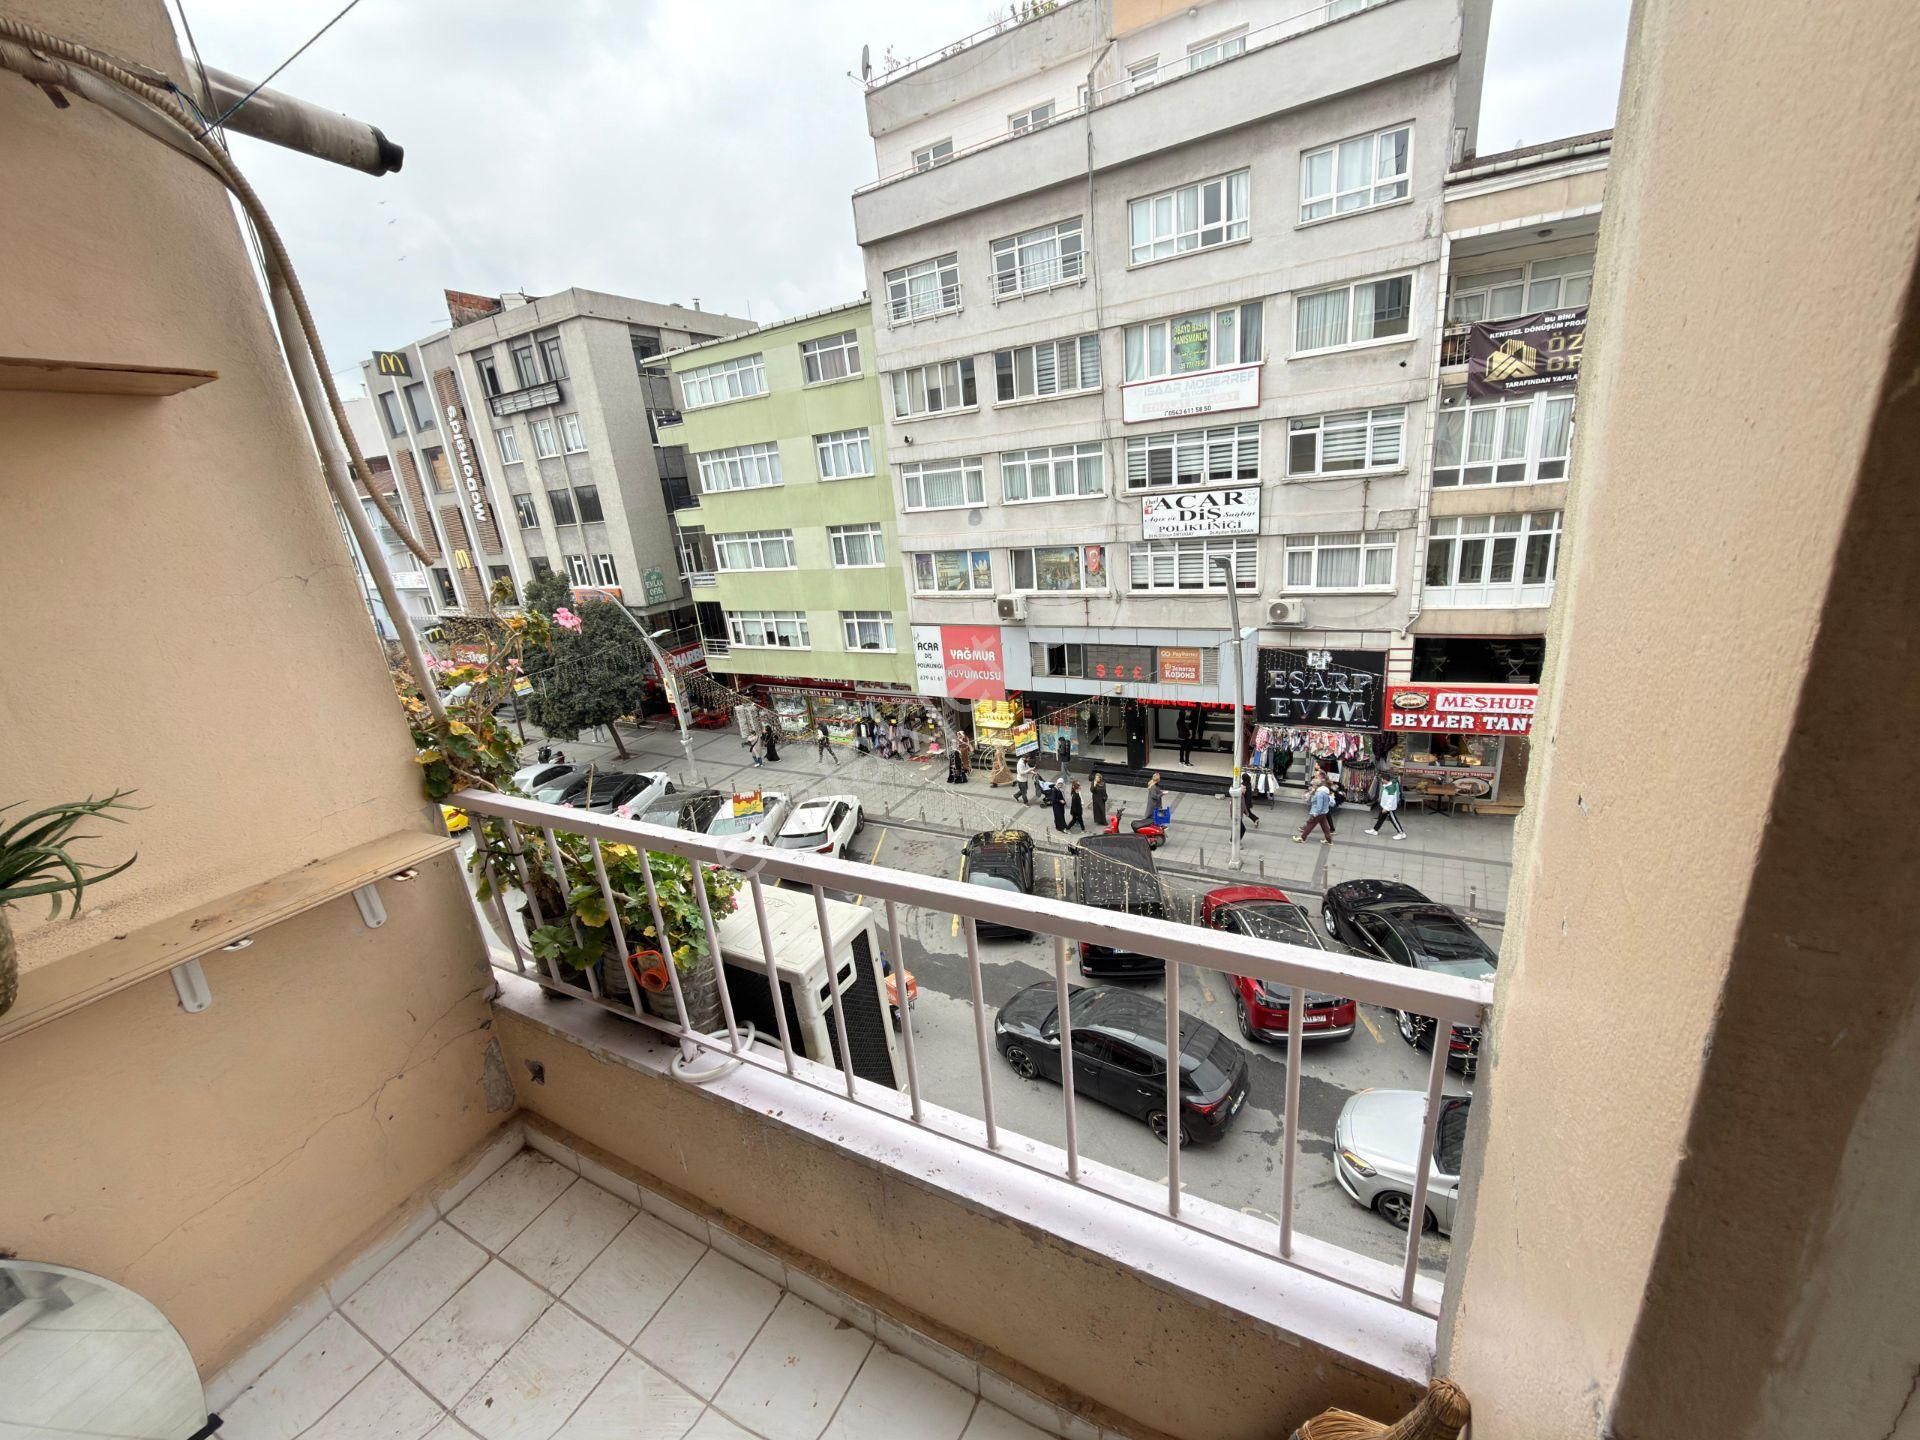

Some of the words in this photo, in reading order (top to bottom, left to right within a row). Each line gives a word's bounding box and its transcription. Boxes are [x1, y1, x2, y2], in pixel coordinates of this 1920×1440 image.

[1544, 316, 1556, 324] BU
[1557, 313, 1576, 322] BİNA
[1489, 328, 1523, 339] KENTSEL
[1524, 323, 1563, 333] DÖNÜŞÜM
[1548, 332, 1583, 353] ÖZ
[1505, 377, 1551, 389] TARAFINDAN
[1154, 491, 1246, 511] ACAR
[1159, 520, 1242, 533] POLİKLİNİĞİ
[917, 642, 939, 651] ACAR
[950, 647, 995, 661] YAĞMUR
[947, 668, 1001, 681] KUYUMCUSU
[1268, 670, 1373, 695] EŞARP
[1270, 694, 1367, 722] EVİM
[1442, 696, 1535, 711] MEŞHUR
[1390, 713, 1475, 729] BEYLER
[1483, 716, 1533, 731] TAN
